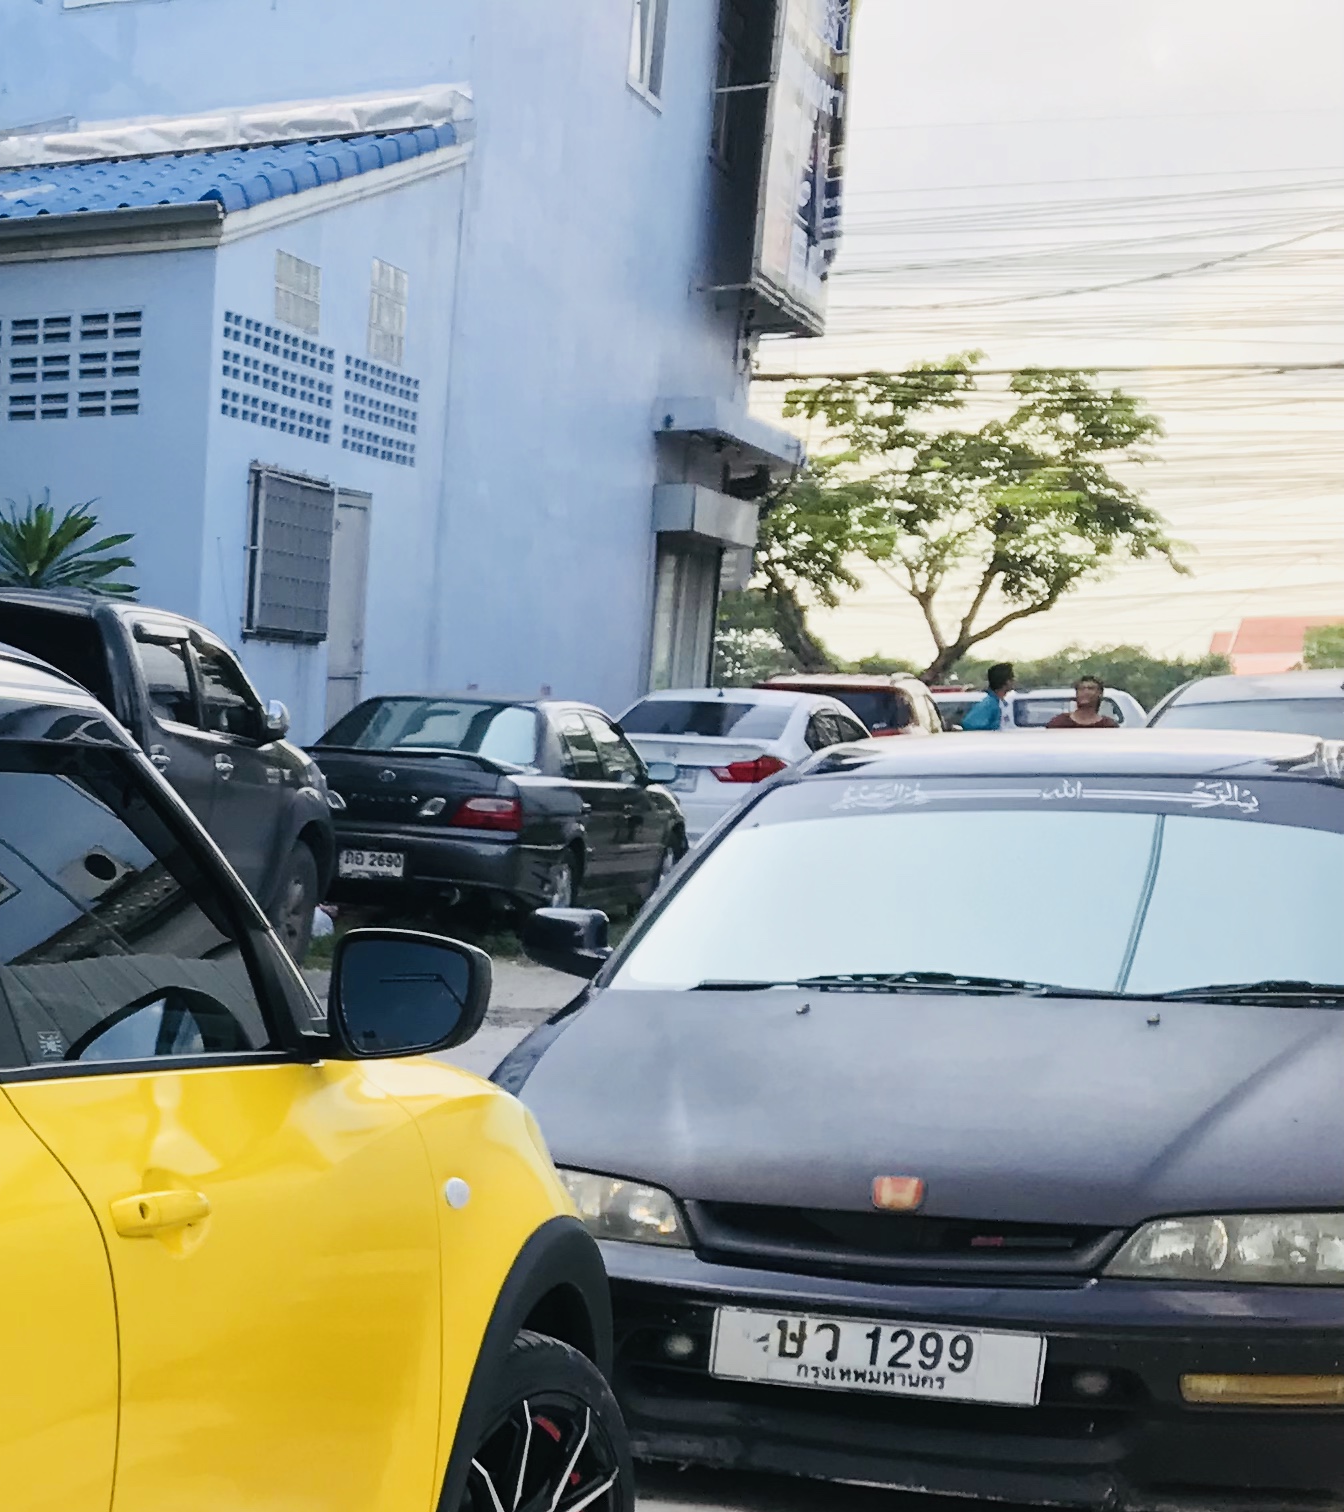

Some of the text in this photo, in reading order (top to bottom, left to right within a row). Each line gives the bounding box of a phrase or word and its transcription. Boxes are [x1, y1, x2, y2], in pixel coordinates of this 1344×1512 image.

[865, 1325, 975, 1374] 1299
[796, 1362, 947, 1390] กรุงเทพมหานคร
